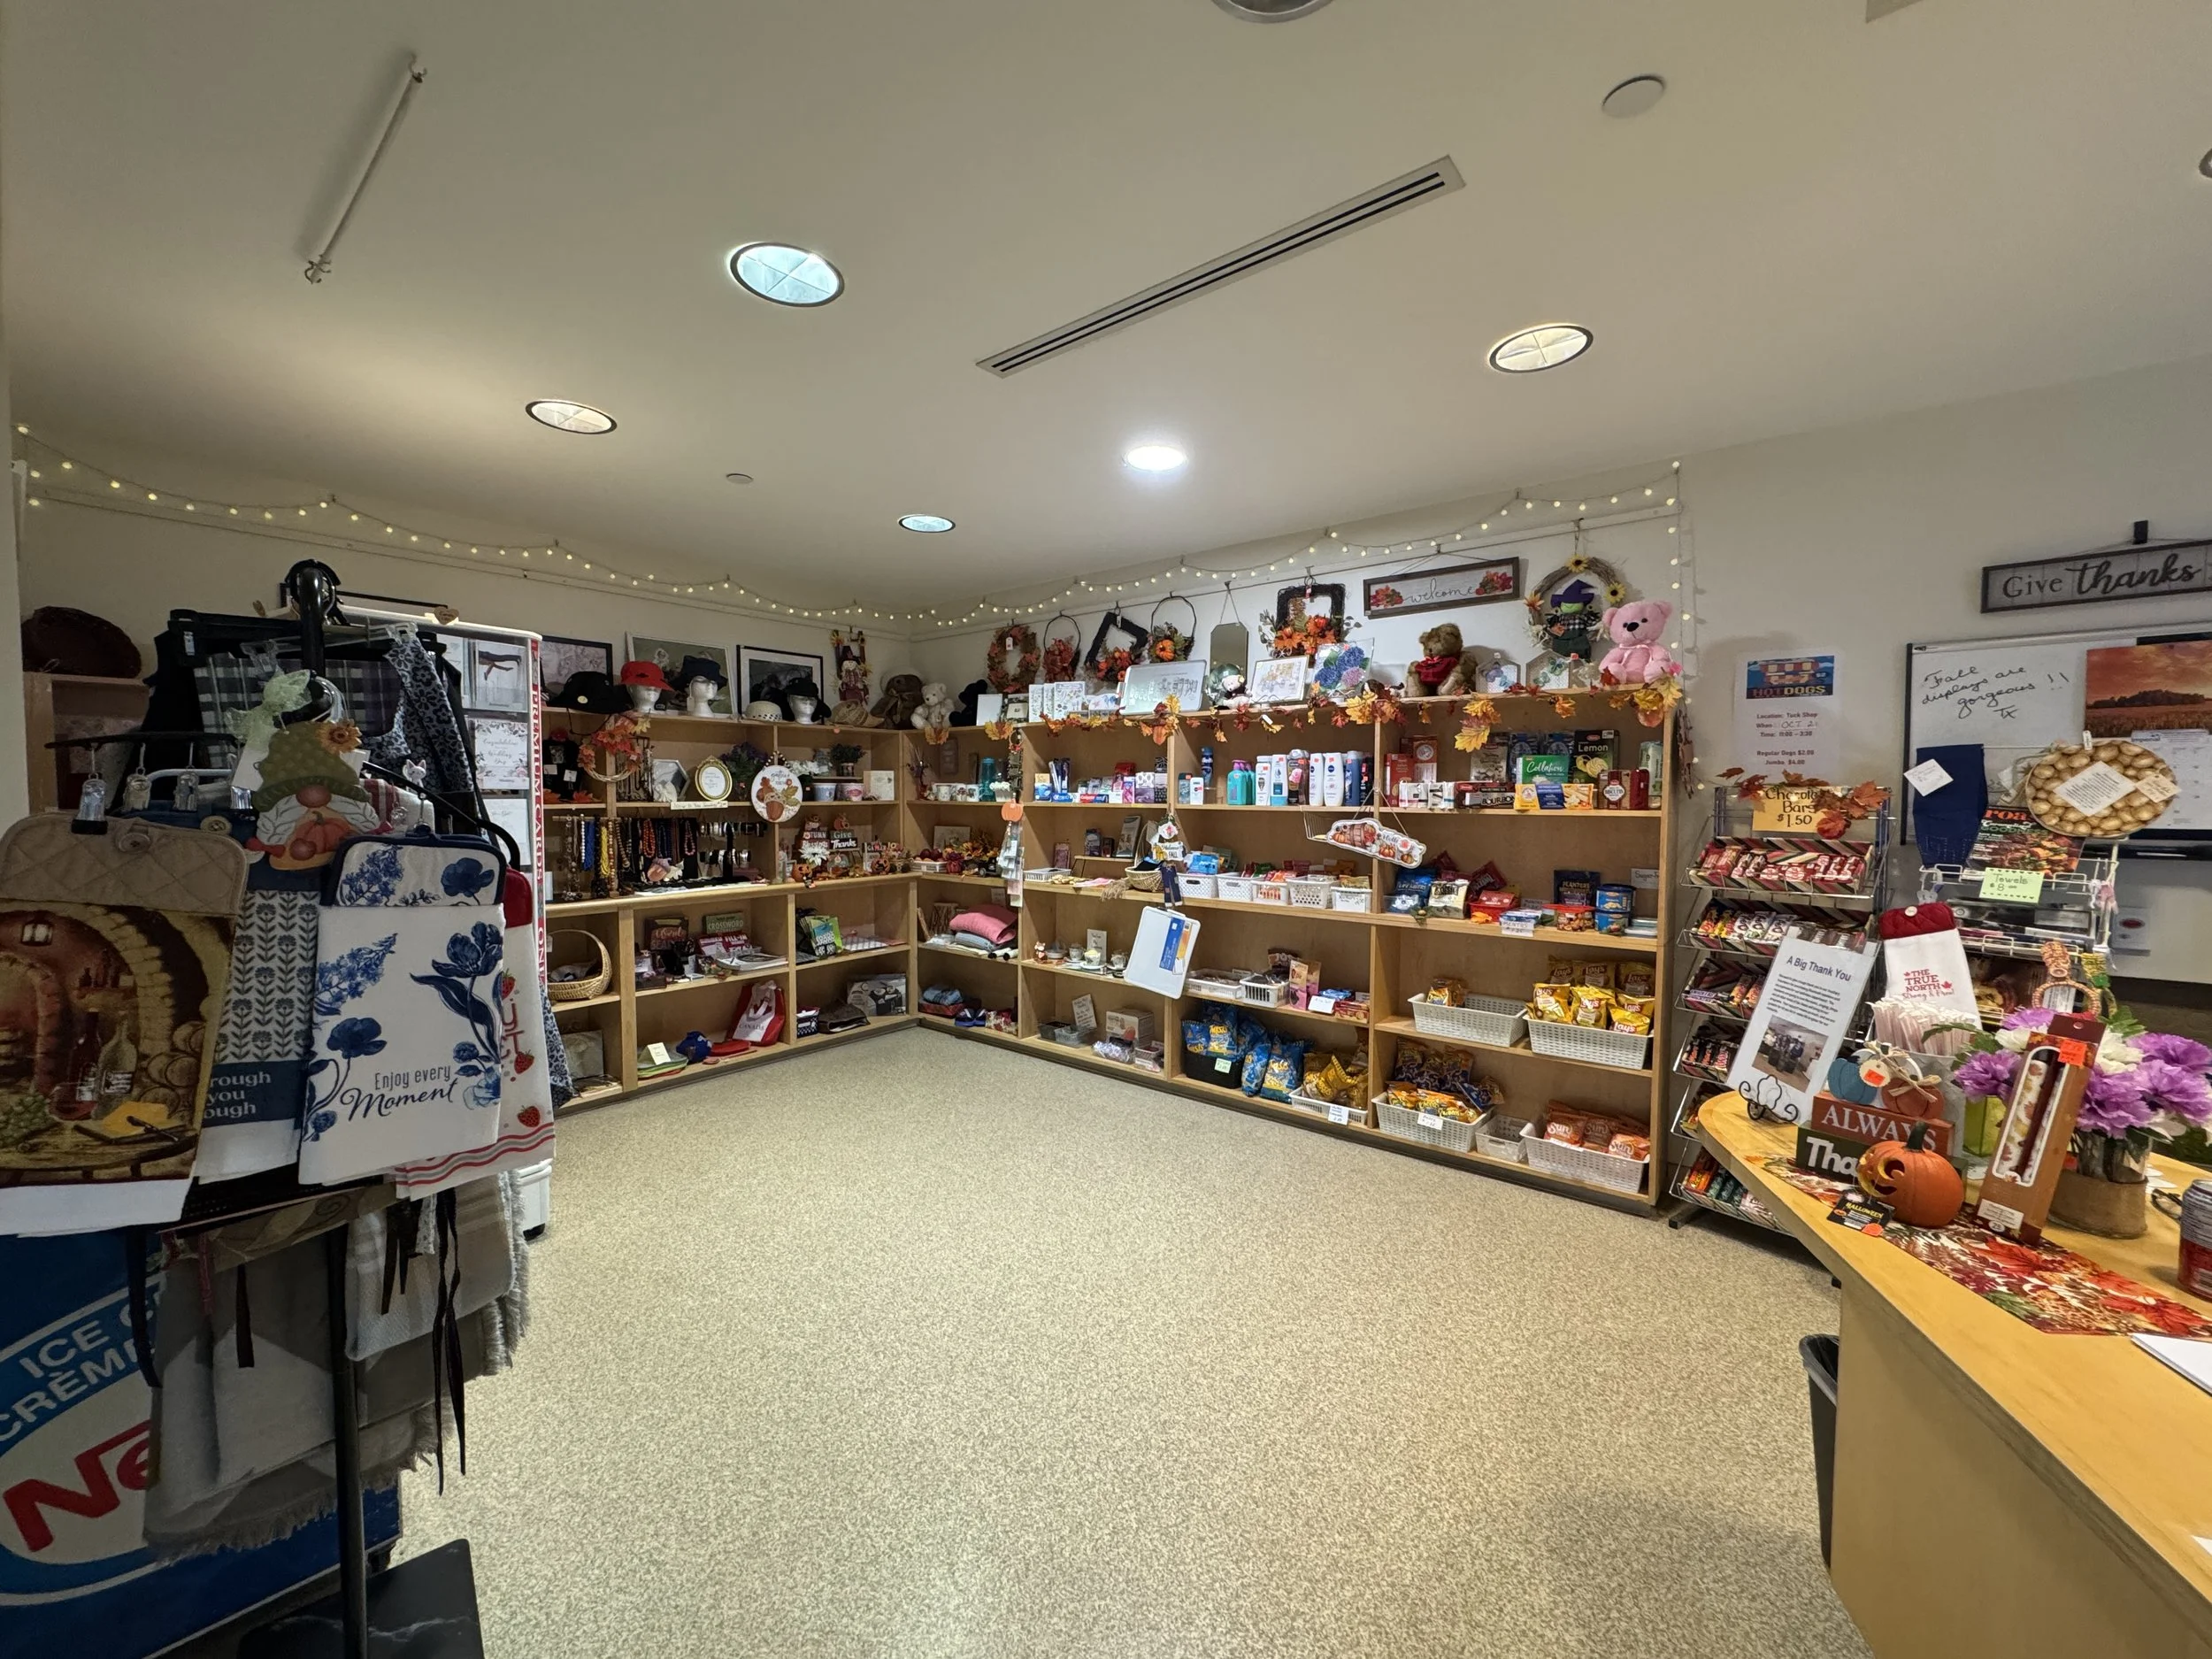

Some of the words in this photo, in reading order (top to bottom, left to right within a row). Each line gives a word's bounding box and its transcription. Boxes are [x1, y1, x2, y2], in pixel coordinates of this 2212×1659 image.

[2002, 575, 2062, 598] Give
[2065, 553, 2201, 595] thanks
[1404, 578, 1475, 603] welcome
[1924, 666, 1978, 688] Fall
[1995, 667, 2026, 679] are
[1753, 688, 1784, 697] HOT
[1784, 685, 1826, 695] DOGS
[1957, 683, 2036, 719] gorgeous
[531, 690, 543, 796] PREMIUM
[1777, 814, 1813, 827] $1.50
[534, 803, 544, 880] CARDS
[831, 839, 856, 849] Thanks
[1993, 873, 2028, 885] Towels
[708, 920, 743, 931] CROSSWORD
[1793, 958, 1808, 971] Big
[1809, 962, 1832, 977] Thank
[1834, 969, 1852, 981] You
[1904, 975, 1939, 986] TRUE
[1905, 983, 1941, 992] NORTH
[1613, 1021, 1636, 1033] Lay's
[374, 1072, 410, 1091] Enjoy
[414, 1064, 451, 1083] every
[206, 1088, 245, 1106] you
[340, 1078, 457, 1122] Moment
[1845, 1202, 1885, 1219] HALLOWEEN
[19, 1319, 110, 1379] ICE
